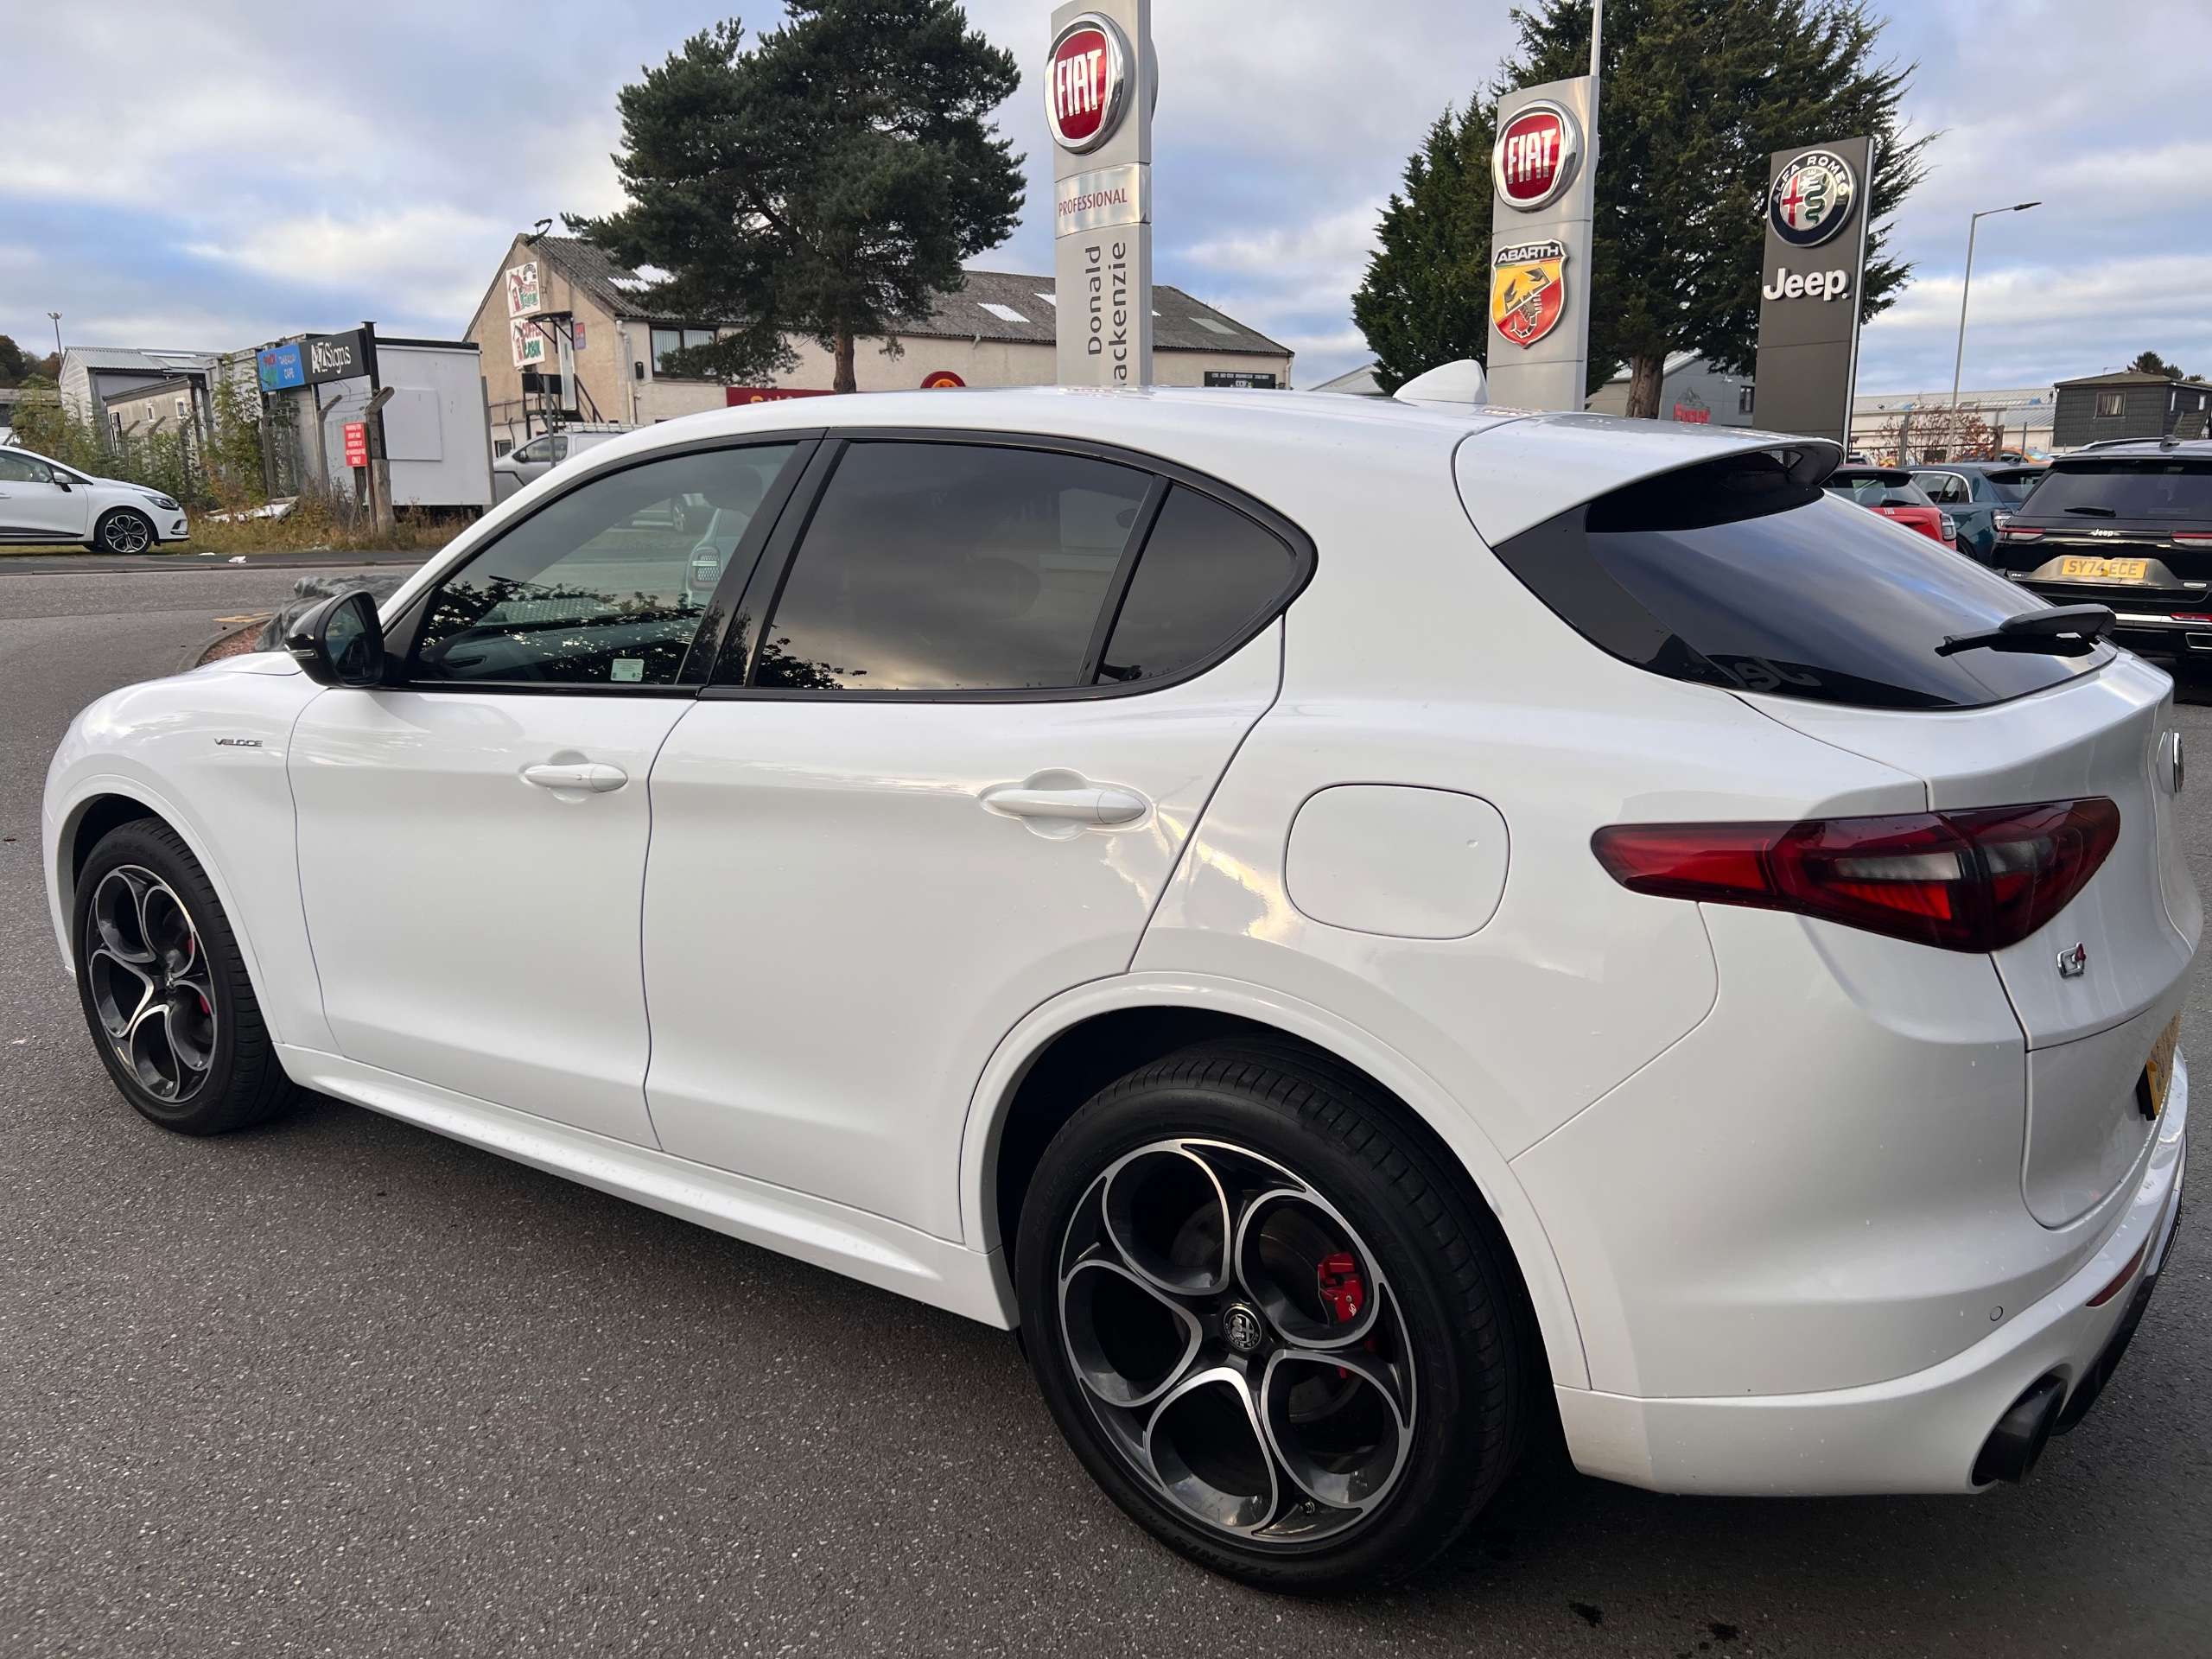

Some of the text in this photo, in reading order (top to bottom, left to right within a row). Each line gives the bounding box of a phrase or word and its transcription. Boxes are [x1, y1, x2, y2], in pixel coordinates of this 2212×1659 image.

[1057, 49, 1102, 119] FIAT
[1507, 128, 1557, 185] FIAT
[1773, 156, 1849, 204] ALFA ROMEO
[1058, 188, 1128, 217] PROFESSIONAL
[1497, 246, 1560, 264] ABARTH
[1084, 245, 1103, 356] Donald
[1763, 267, 1848, 302] Jeep
[1108, 241, 1128, 386] ackenzie
[2091, 528, 2113, 537] Jeep
[2068, 560, 2140, 576] SY74 ECE
